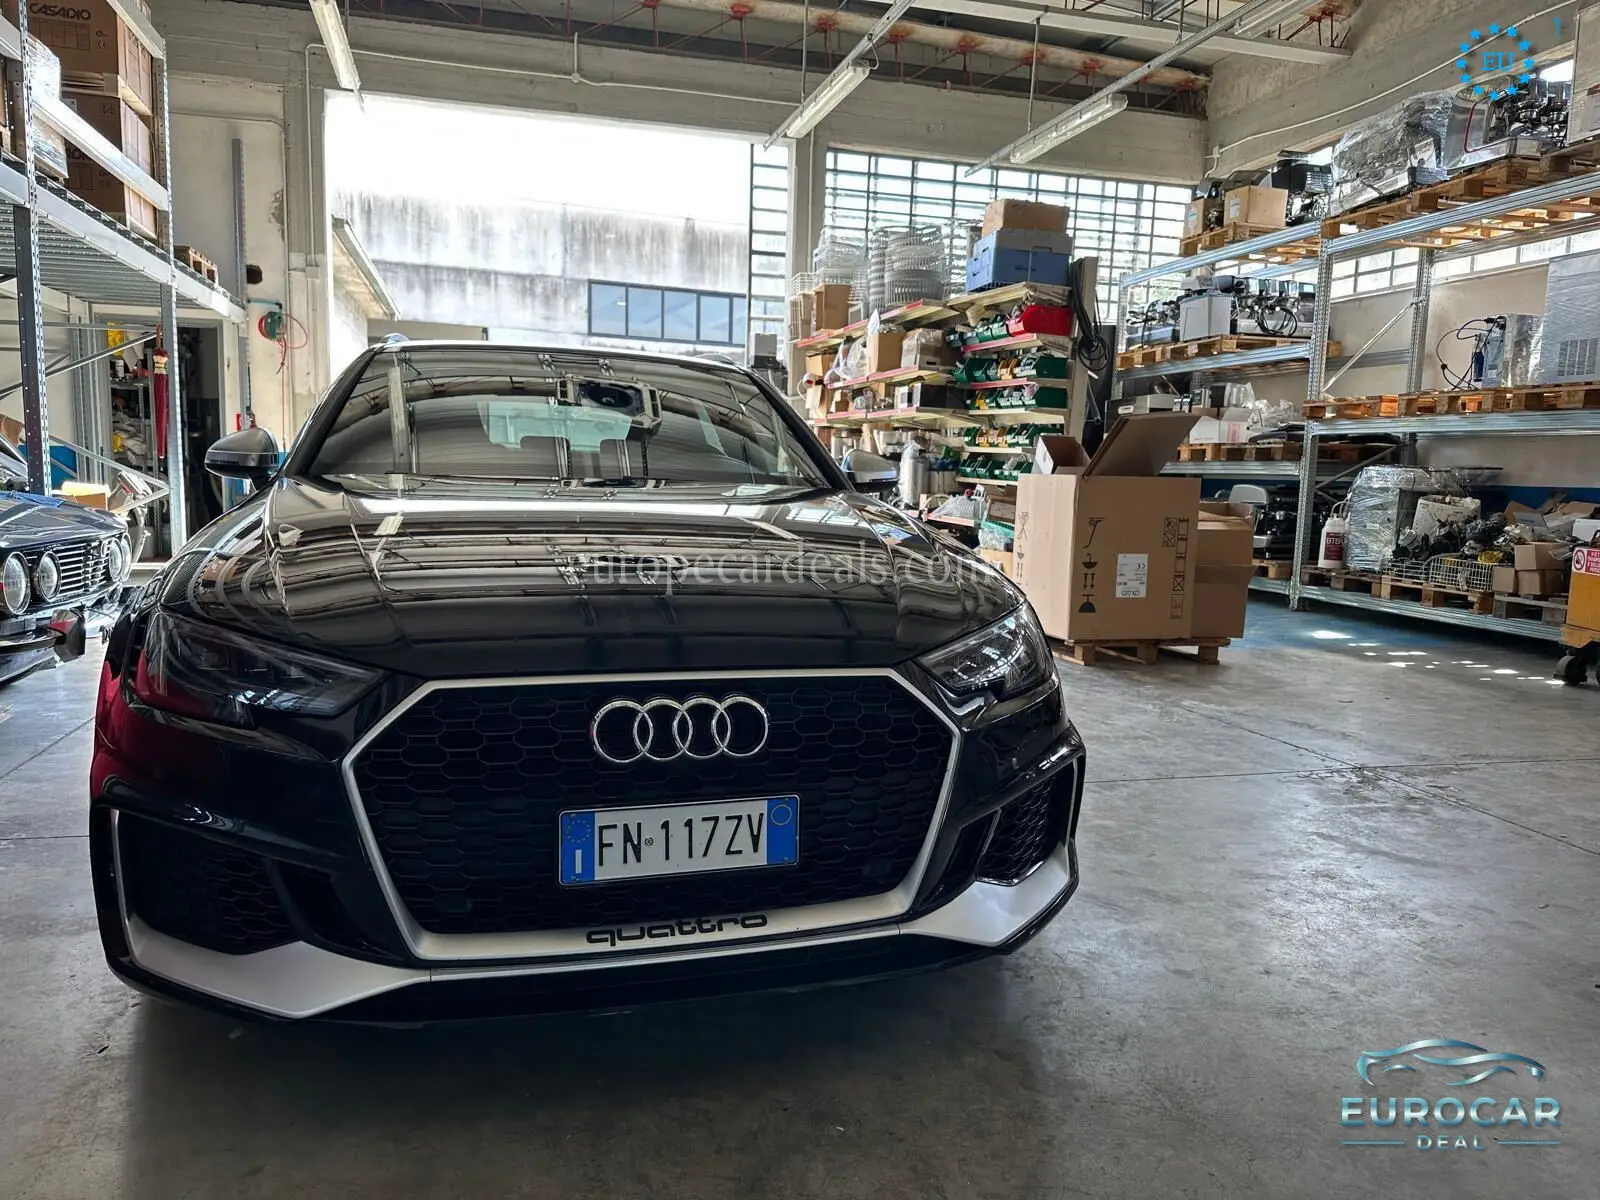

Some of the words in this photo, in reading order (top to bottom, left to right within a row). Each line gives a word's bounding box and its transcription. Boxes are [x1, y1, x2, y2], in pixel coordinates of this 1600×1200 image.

[29, 3, 91, 21] CASADIO
[598, 821, 642, 867] FN
[660, 812, 765, 861] 117ZV
[586, 914, 768, 947] quattro
